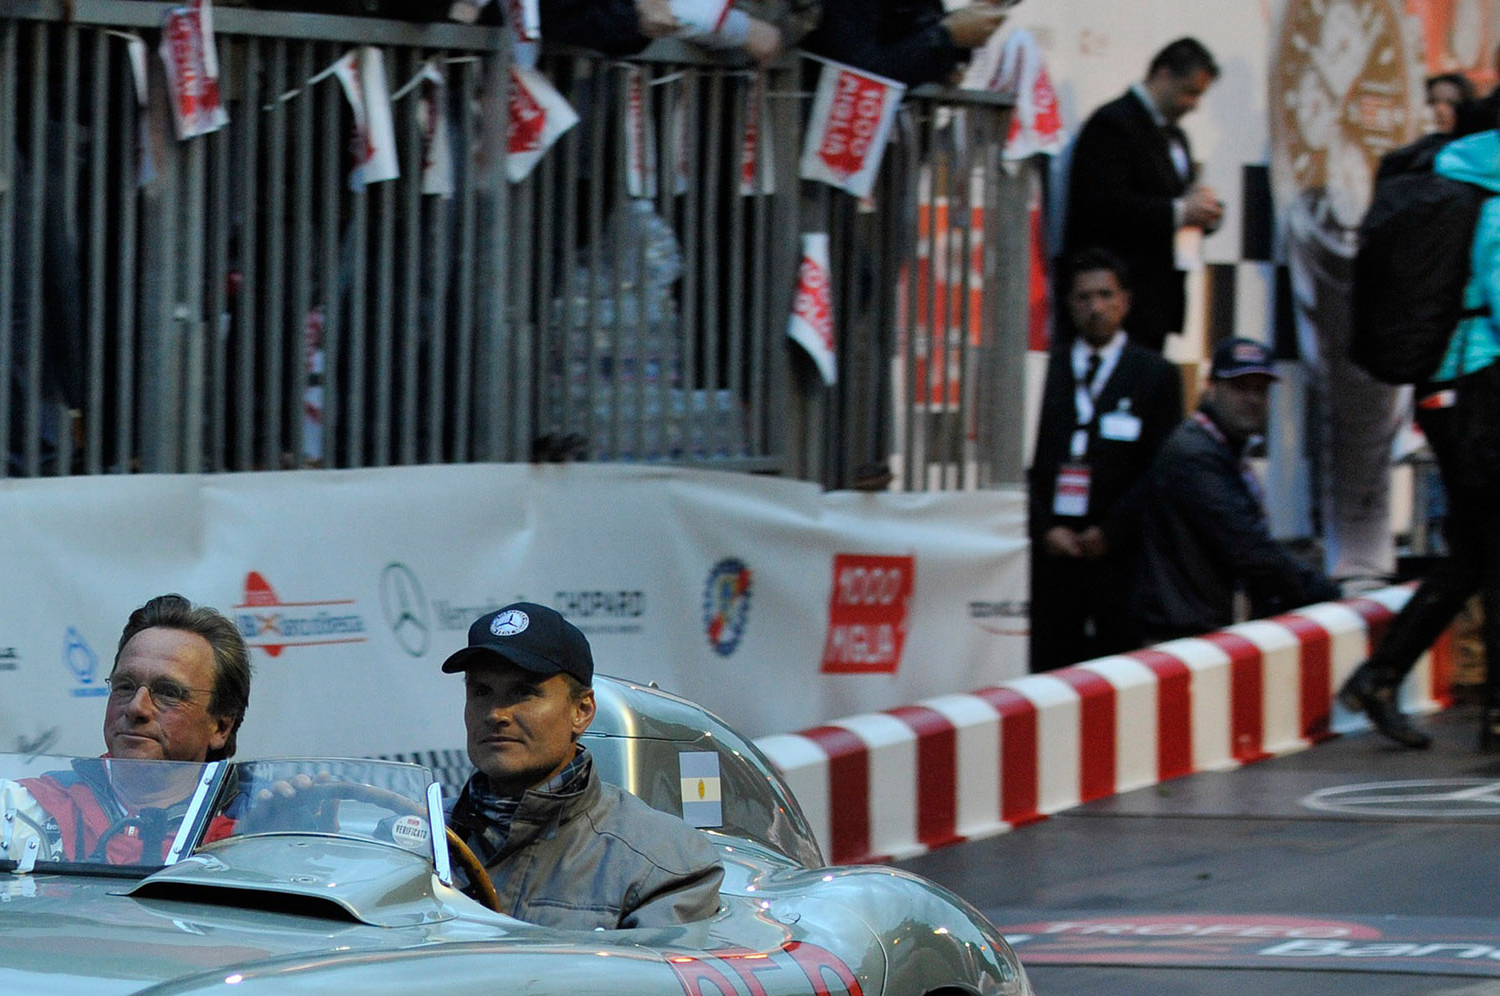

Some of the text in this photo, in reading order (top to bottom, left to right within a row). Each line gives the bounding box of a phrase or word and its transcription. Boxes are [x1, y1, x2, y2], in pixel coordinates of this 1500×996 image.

[838, 566, 900, 605] 1000
[554, 590, 647, 618] CHOPARD
[395, 824, 428, 840] VERIFICATO
[1043, 921, 1350, 938] TROFEO
